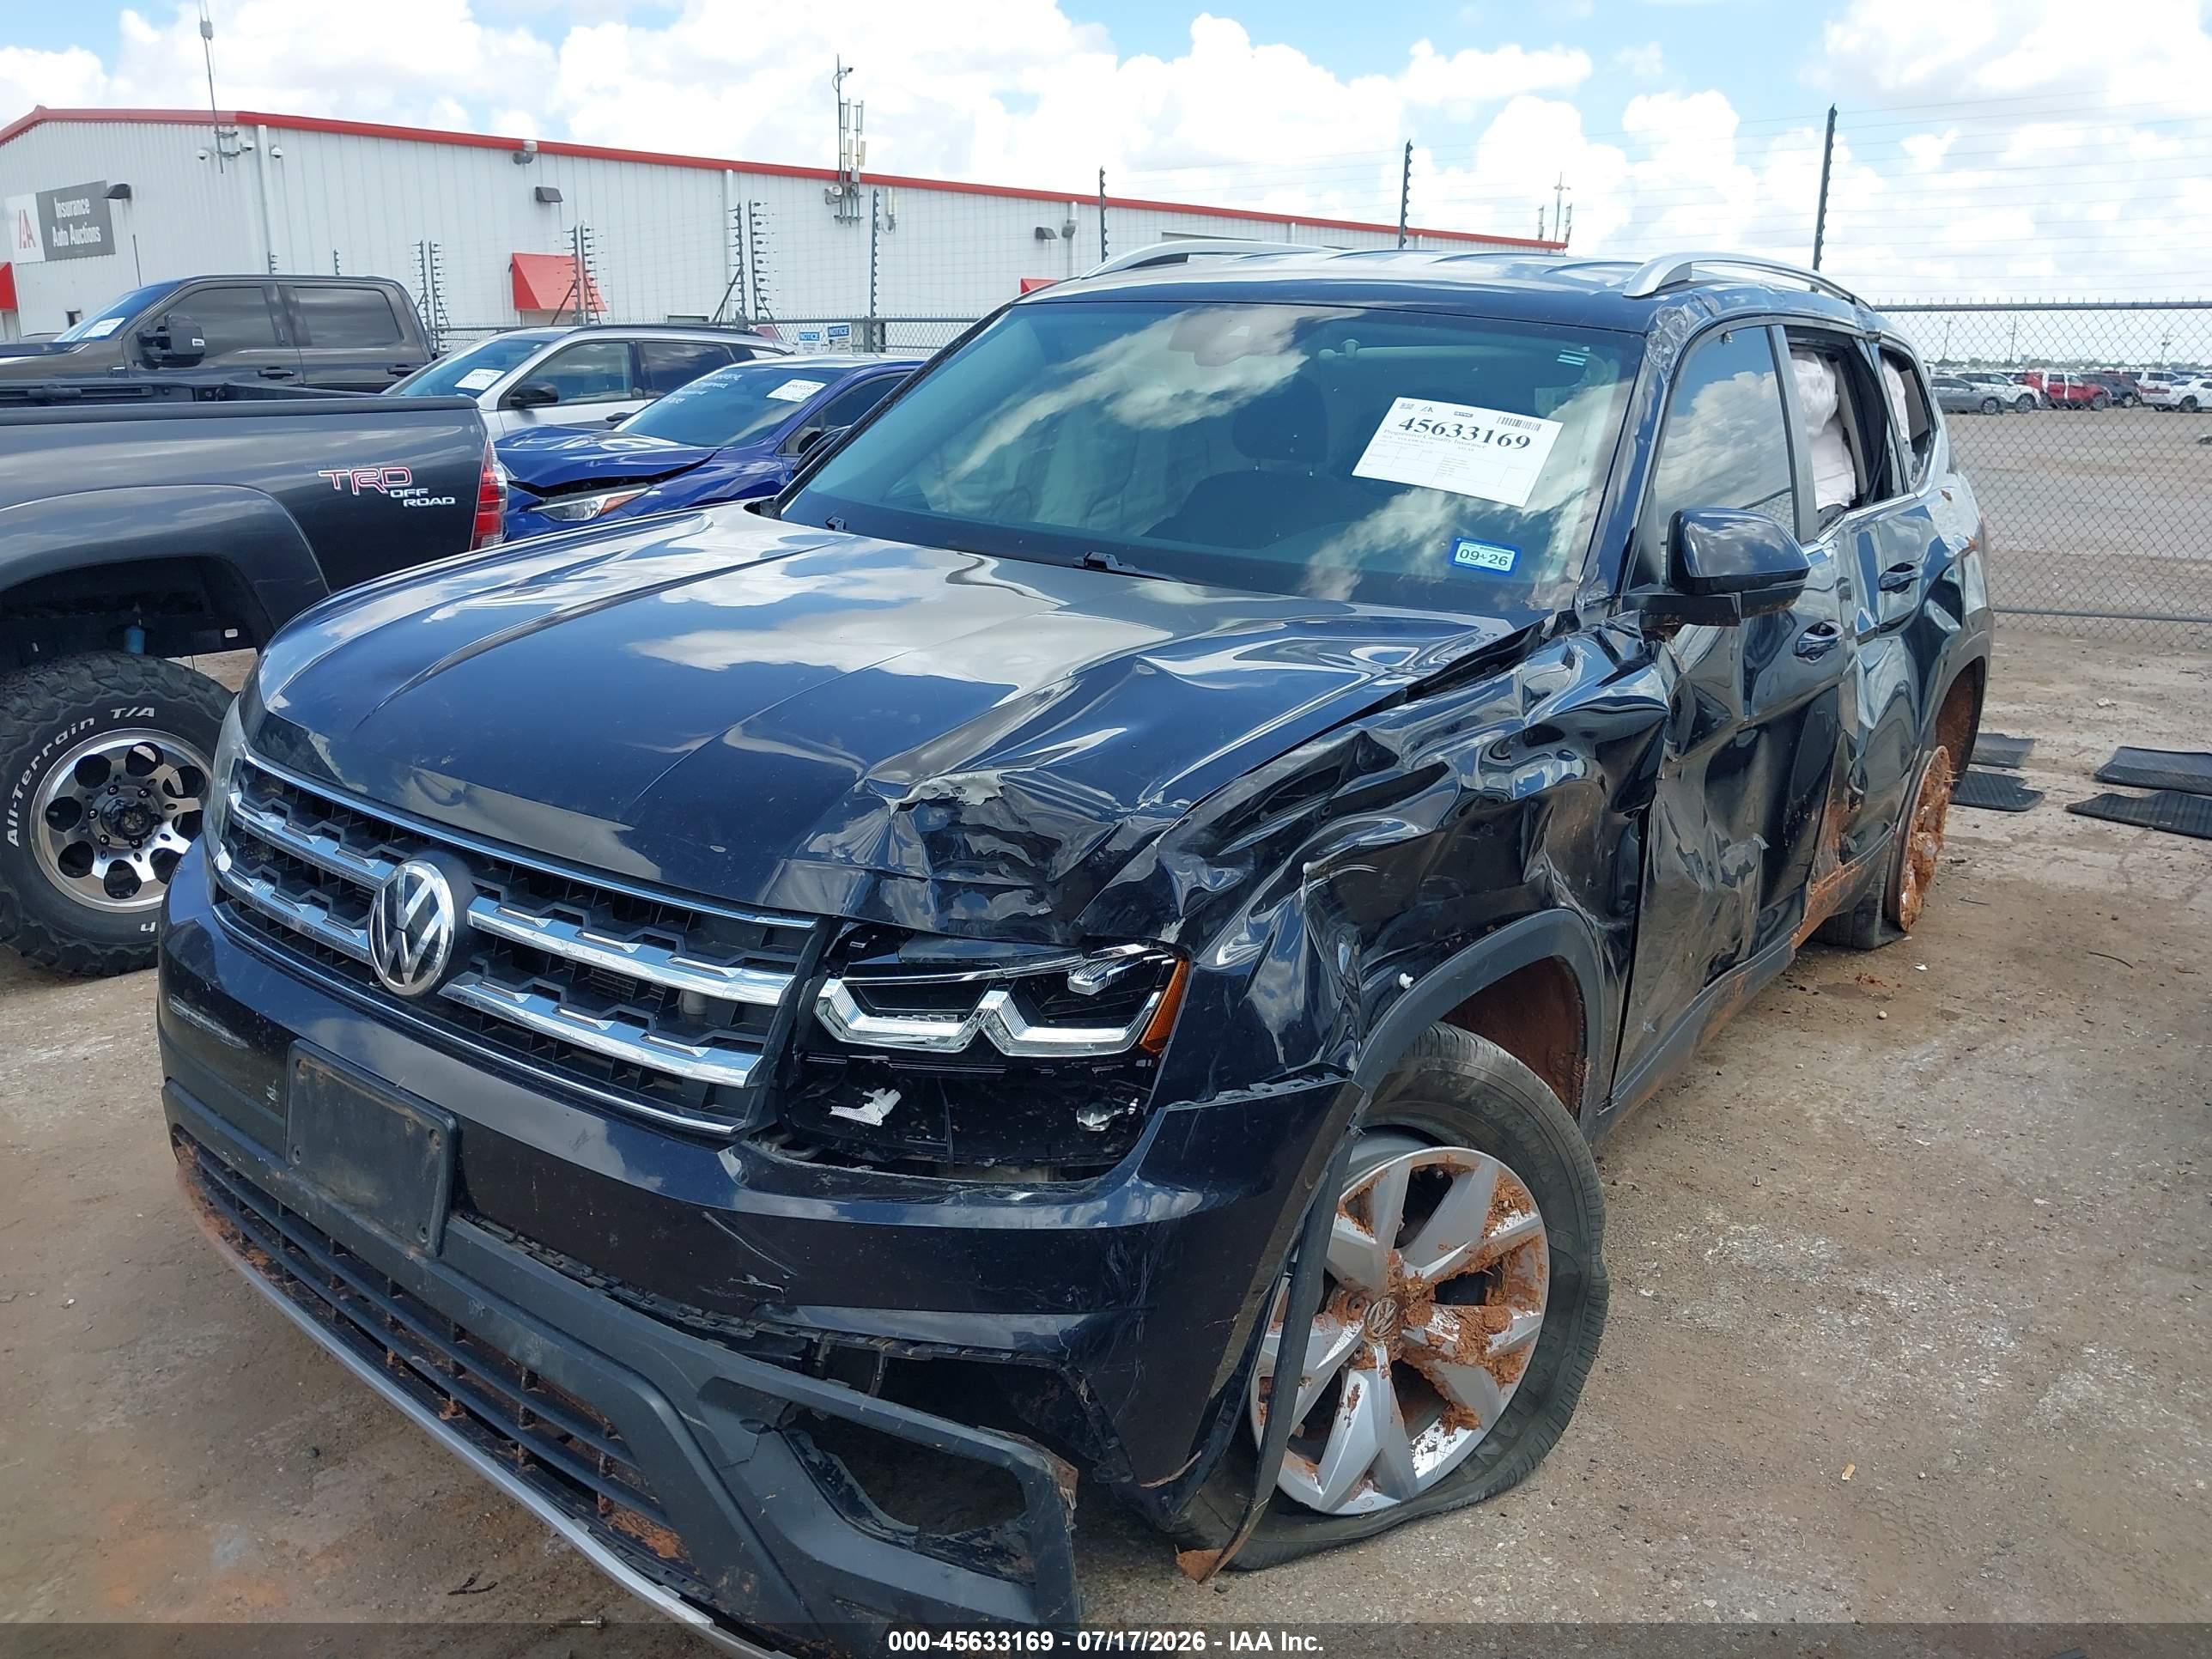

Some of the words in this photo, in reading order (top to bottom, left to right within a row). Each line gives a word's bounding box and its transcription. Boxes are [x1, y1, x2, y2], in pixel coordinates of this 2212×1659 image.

[53, 197, 90, 218] Insurance
[52, 226, 70, 247] Auto
[70, 222, 101, 245] Auctions
[1398, 417, 1531, 449] 45633169
[318, 467, 413, 495] TRD
[390, 488, 428, 498] OFF
[403, 496, 456, 507] ROAD
[7, 717, 95, 848] All-Terrain
[111, 707, 156, 720] T/A
